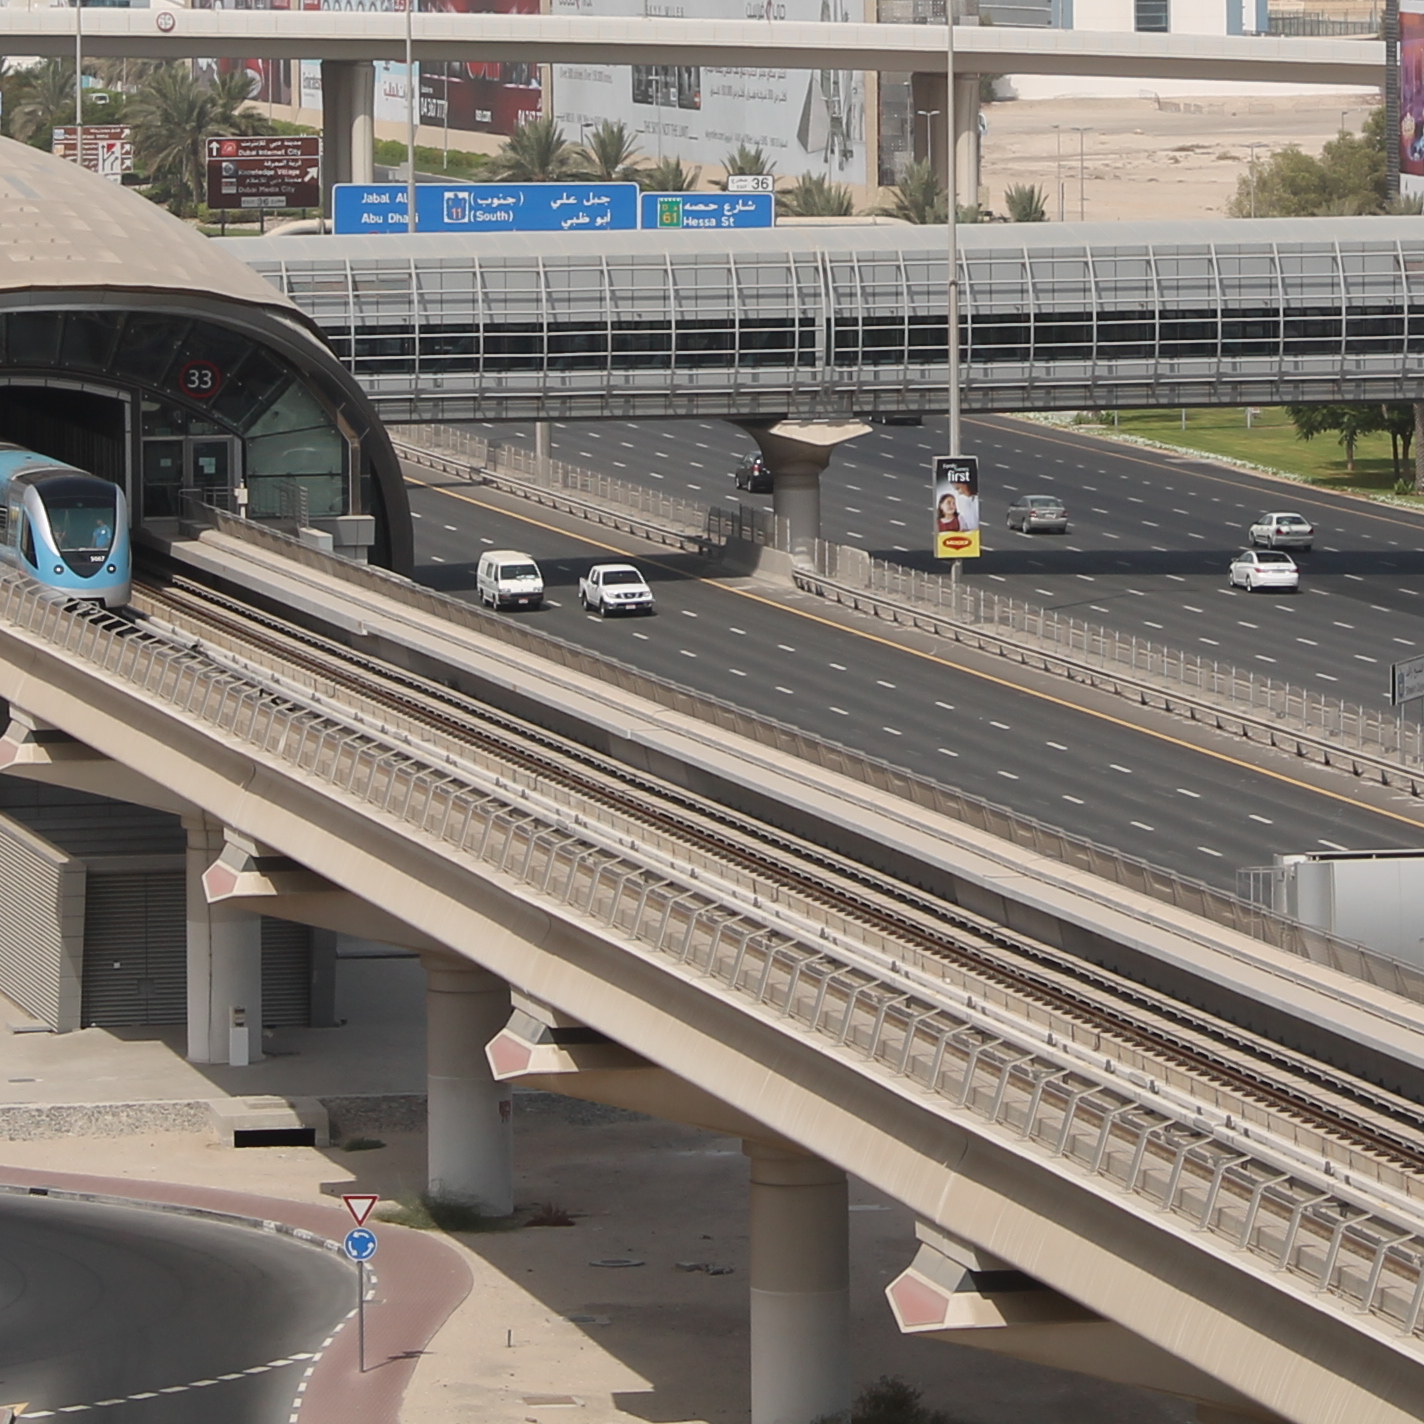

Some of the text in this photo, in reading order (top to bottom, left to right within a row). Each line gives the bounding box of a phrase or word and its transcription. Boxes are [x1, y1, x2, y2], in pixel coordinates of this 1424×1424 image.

[287, 148, 301, 156] City
[277, 168, 300, 176] Village
[238, 185, 295, 193] Dubai Media City
[751, 177, 770, 190] 36
[361, 192, 390, 204] Jabal
[550, 191, 611, 209] جبل علي
[724, 198, 756, 215] شارع
[361, 212, 382, 224] Abu
[451, 208, 462, 219] 11
[470, 210, 514, 223] (South)
[561, 210, 611, 229] أبو ظبي
[683, 216, 735, 226] Hessa St
[187, 369, 212, 389] 33
[947, 470, 970, 482] first
